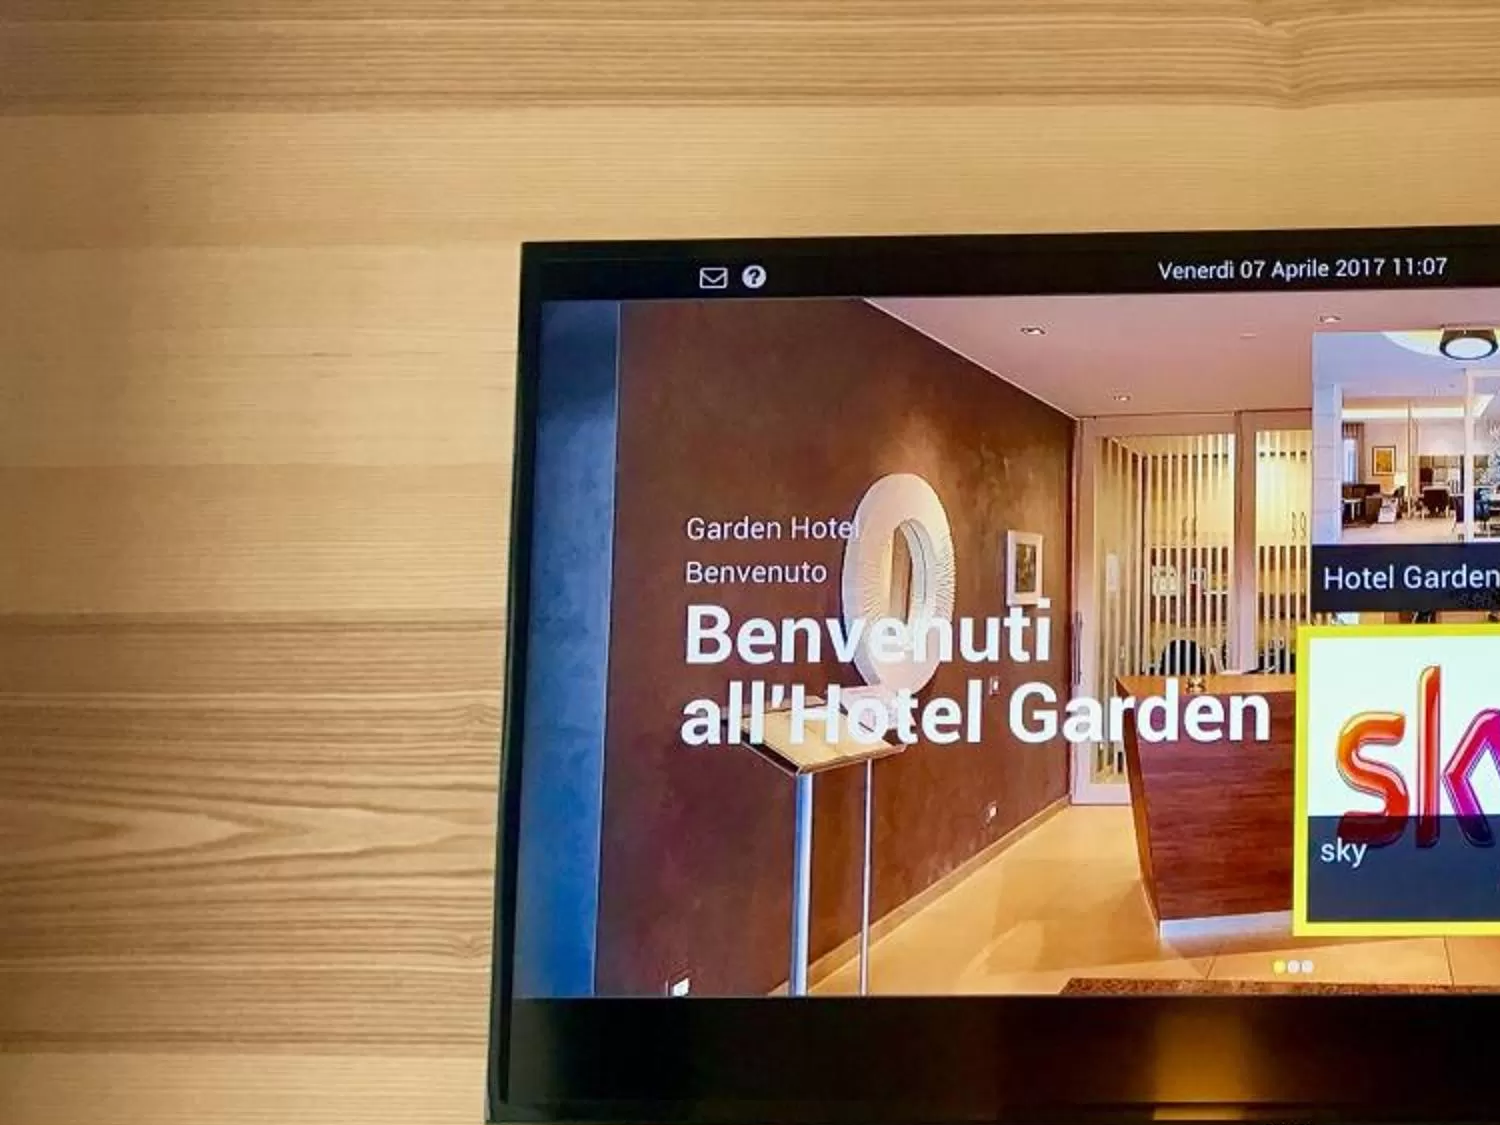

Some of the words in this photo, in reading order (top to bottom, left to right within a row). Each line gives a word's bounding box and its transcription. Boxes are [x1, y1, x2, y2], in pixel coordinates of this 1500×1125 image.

[1239, 261, 1266, 279] 07
[1271, 258, 1329, 282] Aprile
[1335, 258, 1385, 277] 2017
[1392, 257, 1448, 276] 11:07
[686, 516, 781, 540] Garden
[791, 516, 860, 541] Hotel
[686, 561, 827, 584] Benvenuto
[1323, 566, 1395, 590] Hotel
[1403, 564, 1500, 588] Garden
[685, 598, 1052, 664] Benvenuti
[680, 678, 984, 746] all'Hotel
[1008, 678, 1271, 744] Garden
[1320, 837, 1368, 868] sky
